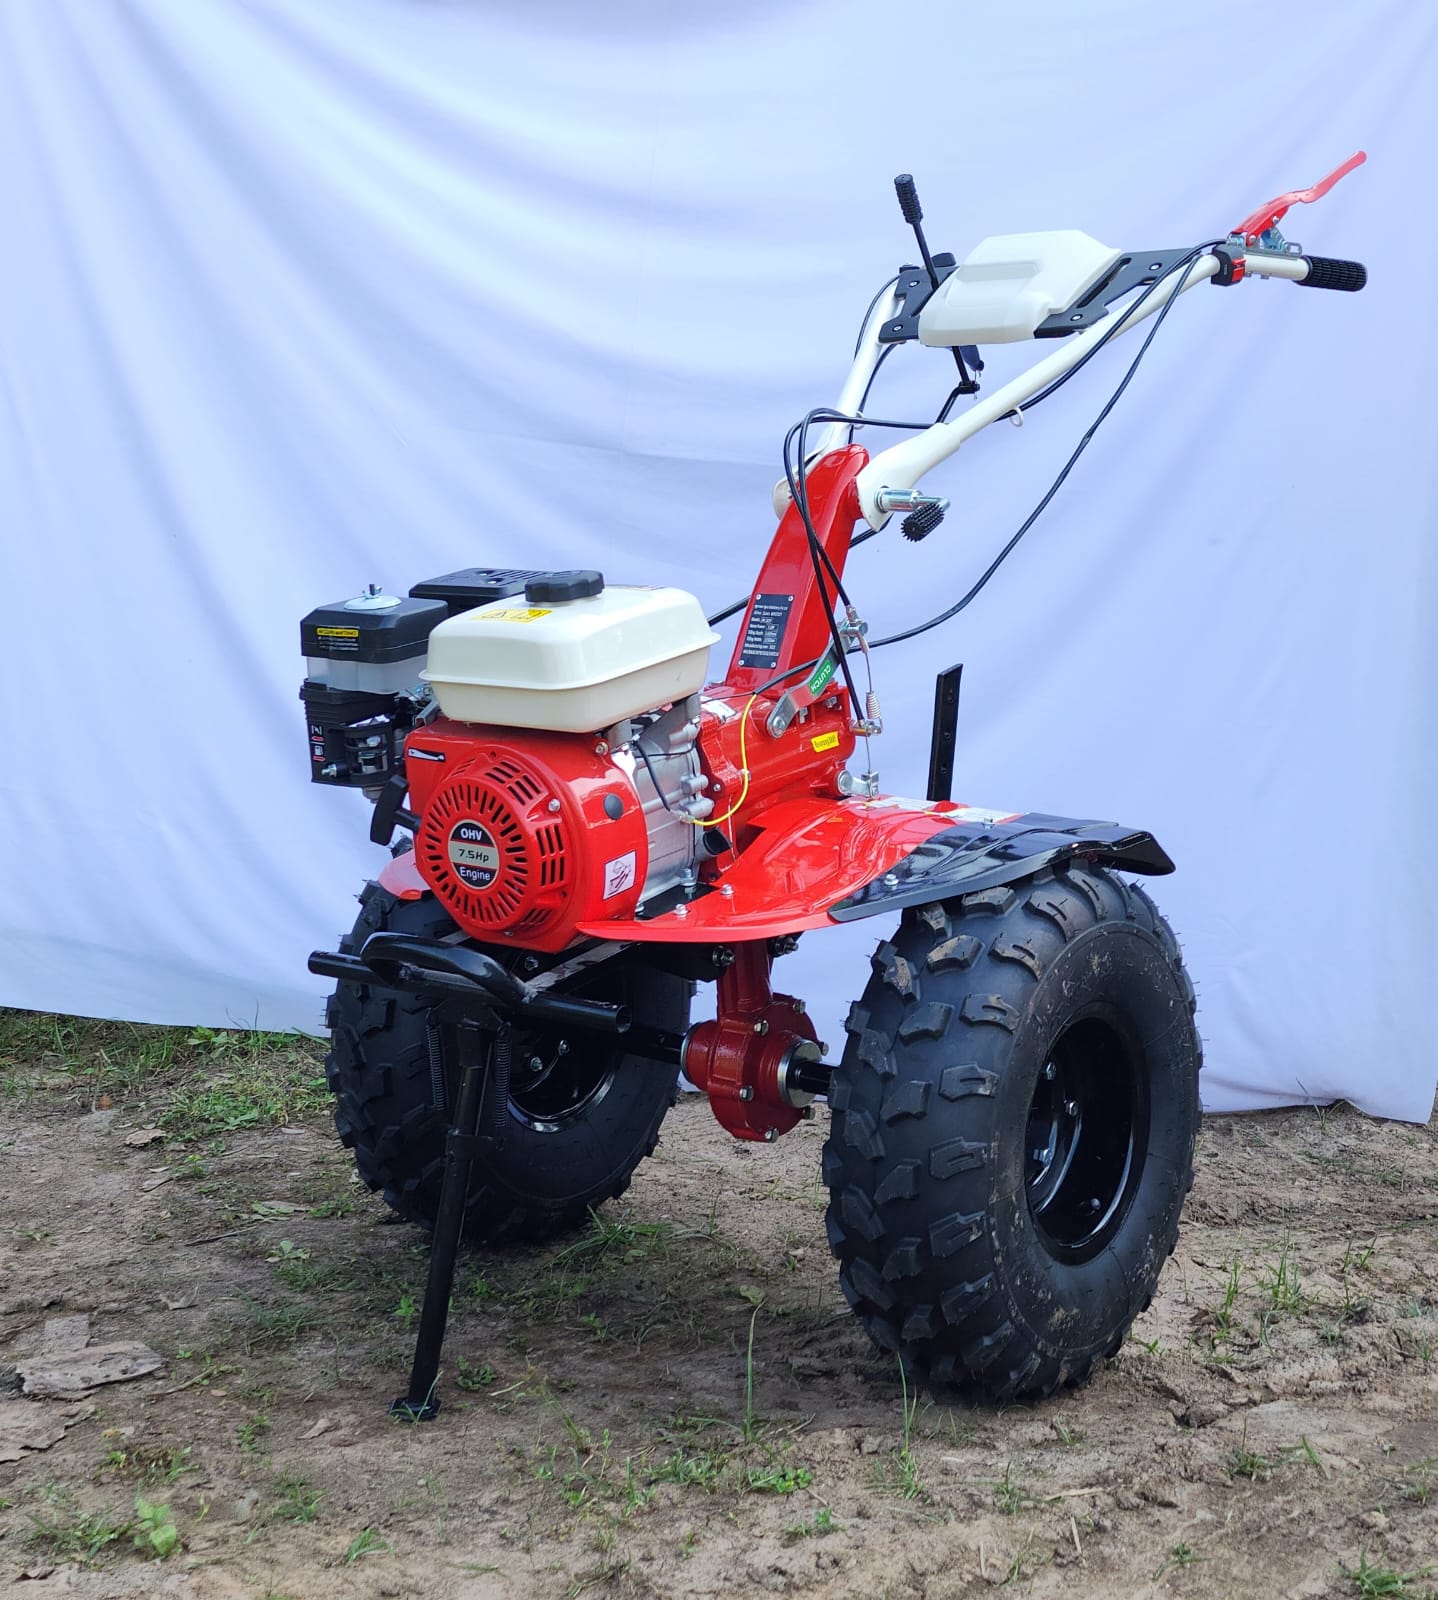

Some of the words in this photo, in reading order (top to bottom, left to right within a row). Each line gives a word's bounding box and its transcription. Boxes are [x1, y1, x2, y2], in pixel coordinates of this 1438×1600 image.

[811, 664, 831, 691] CLUTCH
[460, 828, 483, 841] OHV
[458, 849, 490, 862] 7.5Hp
[460, 866, 491, 881] Engine
